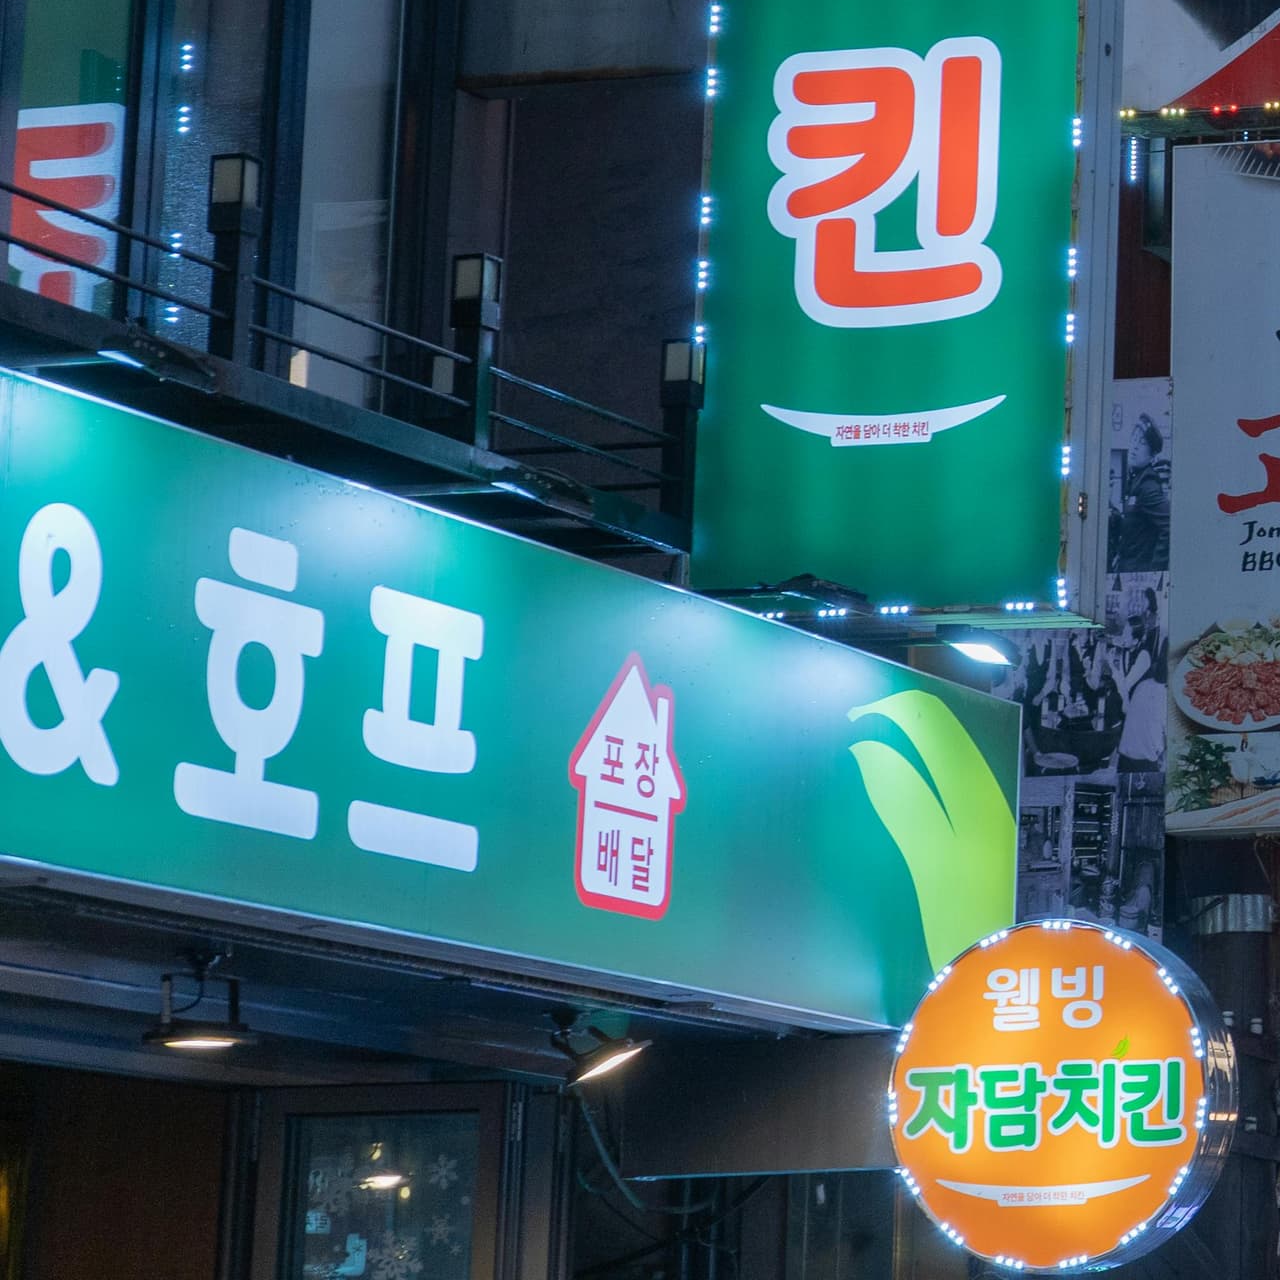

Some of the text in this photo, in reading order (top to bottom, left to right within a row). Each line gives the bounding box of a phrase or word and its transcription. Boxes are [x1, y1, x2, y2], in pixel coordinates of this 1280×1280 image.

[882, 423, 891, 438] 더
[912, 421, 928, 436] 치킨
[174, 527, 485, 872] 호프
[600, 735, 660, 798] 포장
[597, 829, 654, 892] 배달
[983, 965, 1105, 1031] 웰빙
[903, 1056, 1187, 1154] 자담치킨
